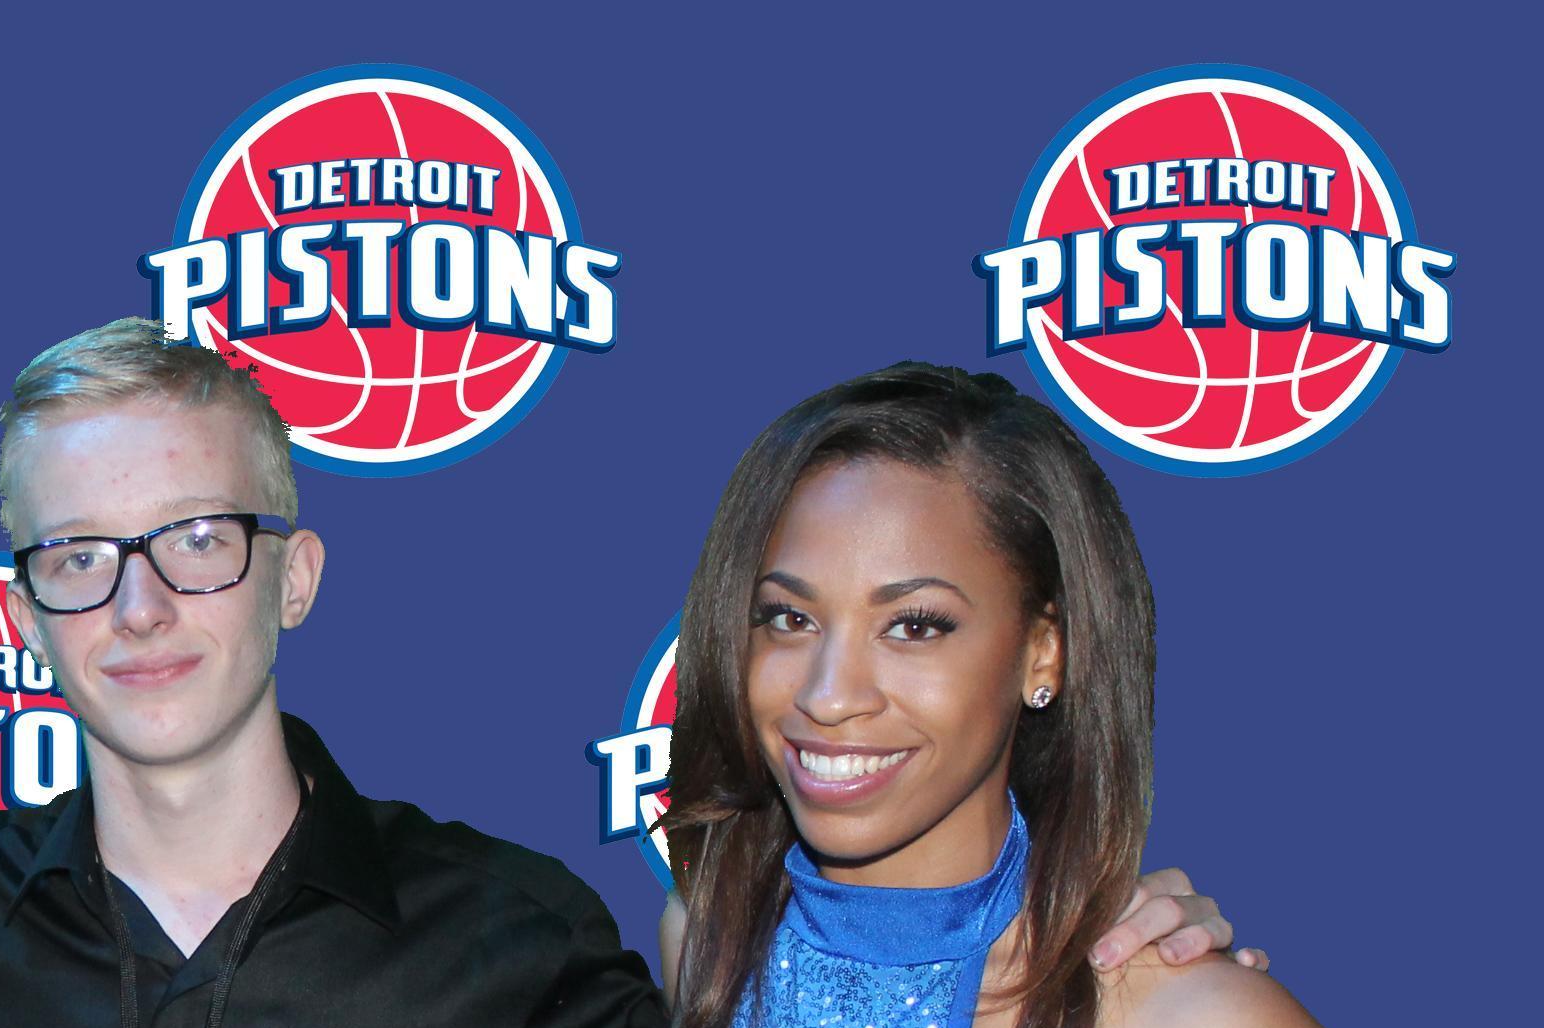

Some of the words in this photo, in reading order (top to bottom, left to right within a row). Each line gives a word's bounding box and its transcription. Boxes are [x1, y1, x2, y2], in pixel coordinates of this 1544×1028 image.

[272, 157, 501, 212] DETROIT
[1106, 157, 1335, 212] DETROIT
[142, 220, 621, 354] PISTONS
[976, 220, 1455, 354] PISTONS
